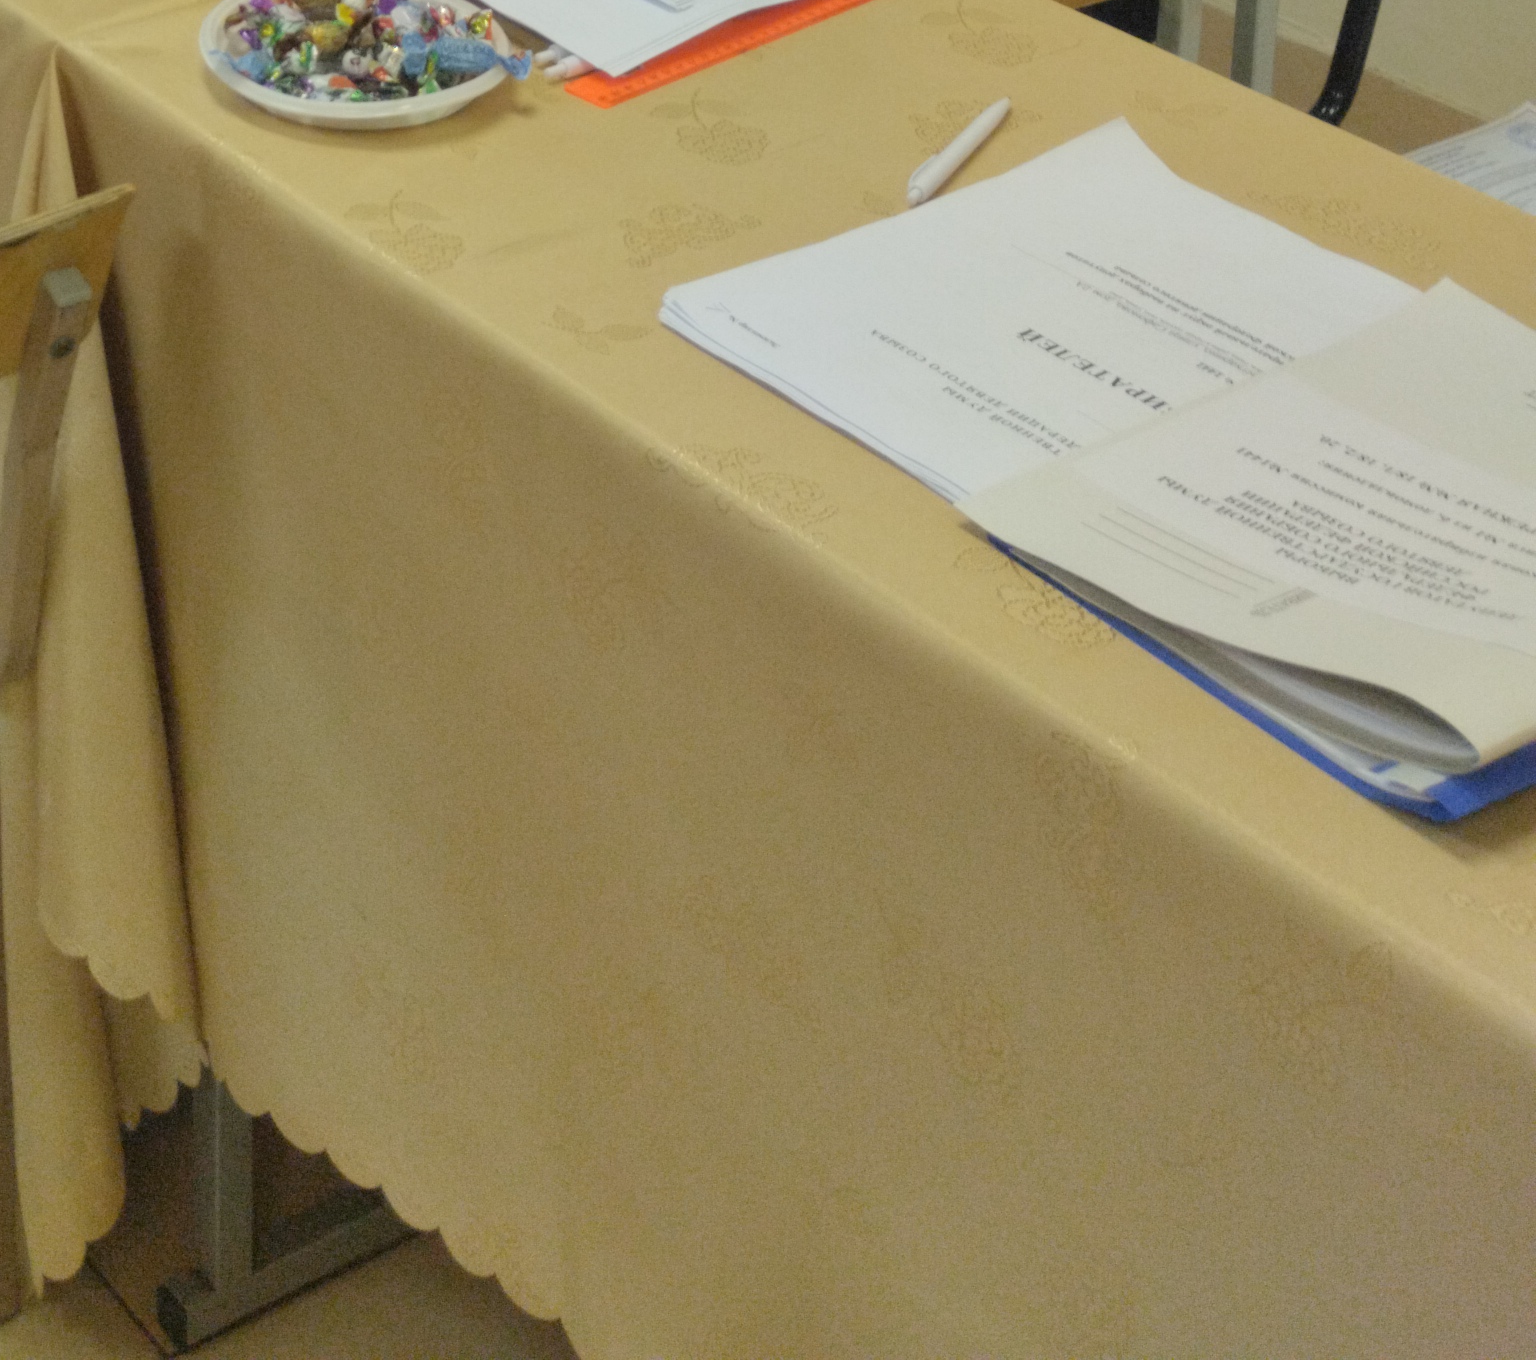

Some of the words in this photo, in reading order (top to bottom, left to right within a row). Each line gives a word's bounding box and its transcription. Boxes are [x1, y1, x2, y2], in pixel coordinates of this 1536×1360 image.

[871, 329, 926, 362] СОЗЫВА
[929, 363, 1005, 407] ДЕВЯТОГО
[942, 386, 987, 412] ДУМЫ
